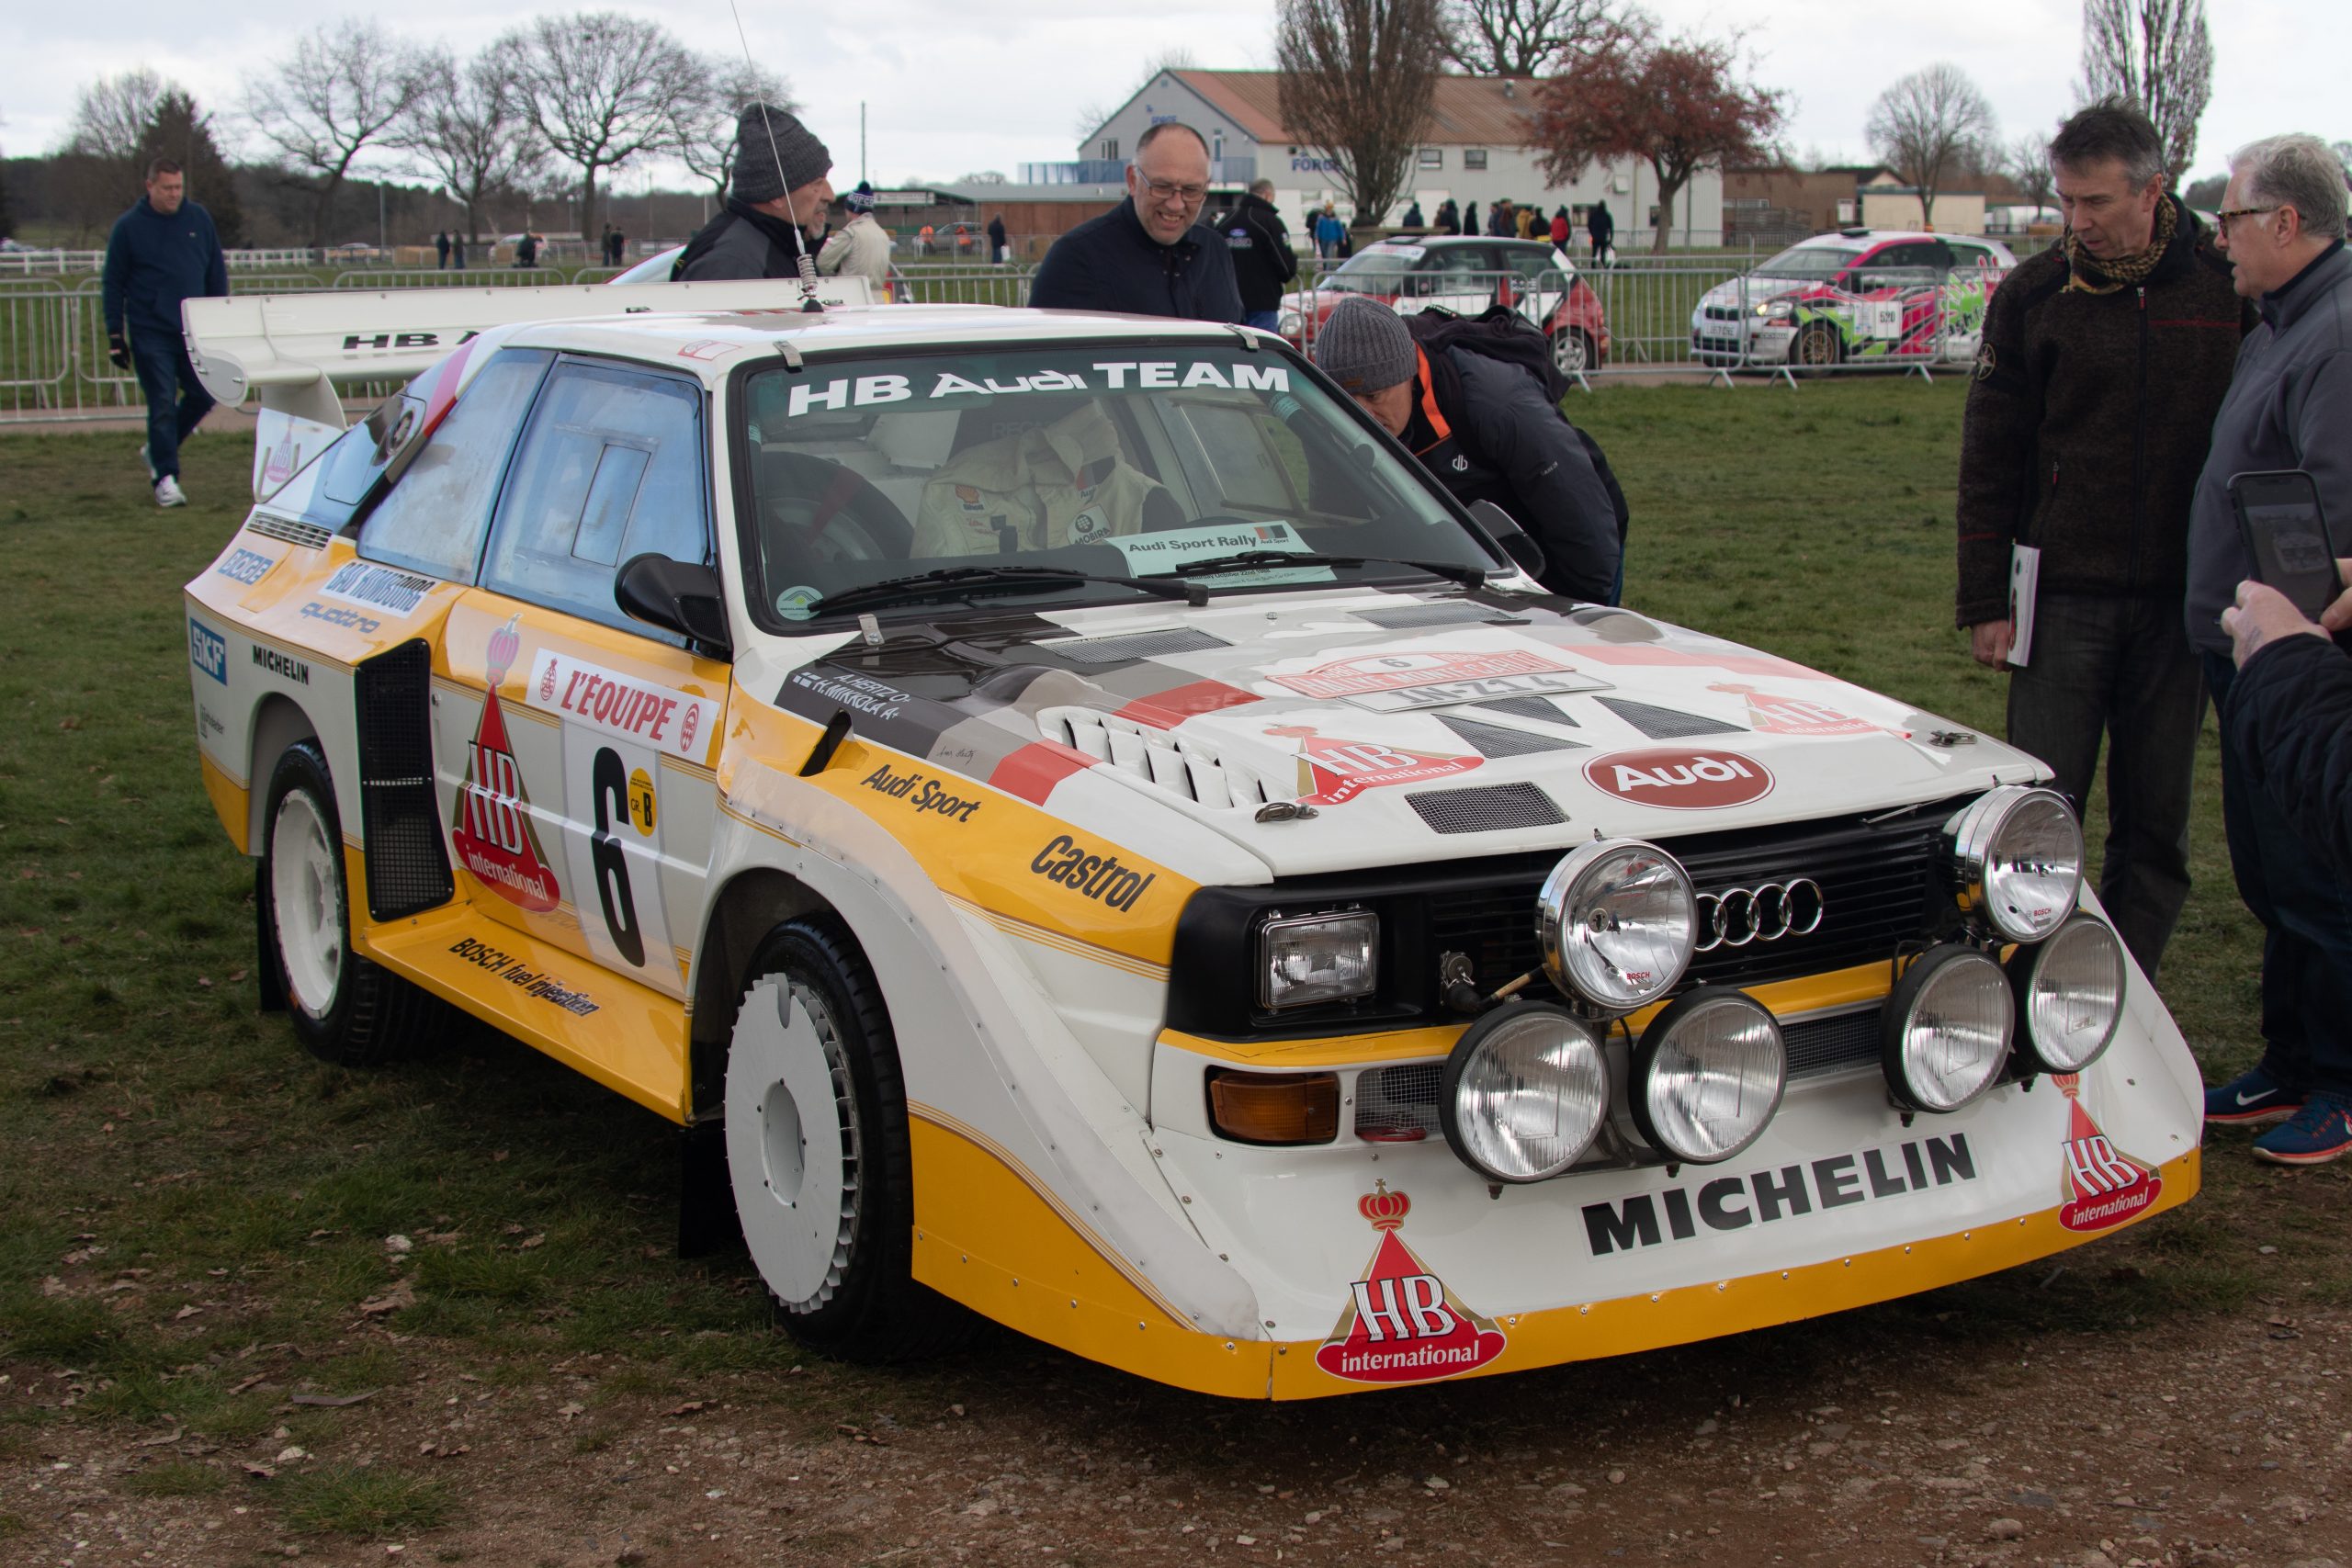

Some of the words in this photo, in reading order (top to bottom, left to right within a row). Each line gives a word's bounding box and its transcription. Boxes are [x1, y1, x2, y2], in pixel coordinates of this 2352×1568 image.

[343, 333, 439, 350] HB
[788, 374, 912, 417] HB
[929, 369, 1088, 398] Audi
[1092, 362, 1290, 392] TEAM
[1074, 526, 1110, 546] MOBIRA
[1129, 540, 1167, 551] Audi
[1169, 537, 1215, 551] Sport
[1218, 535, 1257, 549] Rally
[219, 549, 272, 585] BOGE
[300, 602, 381, 634] quattro
[192, 627, 225, 678] SKF
[252, 644, 310, 685] MICHELIN
[1381, 657, 1412, 669] 6
[1288, 674, 1396, 695] RALLYE
[560, 670, 678, 741] L'ÉQUIPE
[1748, 701, 1854, 726] HB
[1290, 743, 1419, 777] HB
[1611, 756, 1754, 792] Audi
[468, 739, 523, 856] HB
[860, 763, 922, 799] Audi
[910, 779, 982, 823] Sport
[1322, 760, 1465, 804] international
[642, 792, 653, 828] B
[466, 843, 549, 903] international
[591, 746, 646, 967] 6
[1030, 834, 1157, 913] Castrol
[2033, 908, 2052, 917] BOSCH
[447, 937, 514, 972] BOSCH
[498, 964, 545, 987] fuel
[1626, 970, 1650, 980] BOSCH
[2062, 1134, 2140, 1199] HB
[1581, 1133, 1975, 1257] MICHELIN
[2072, 1186, 2149, 1227] international
[1350, 1273, 1457, 1343] HB
[1341, 1339, 1480, 1373] international
